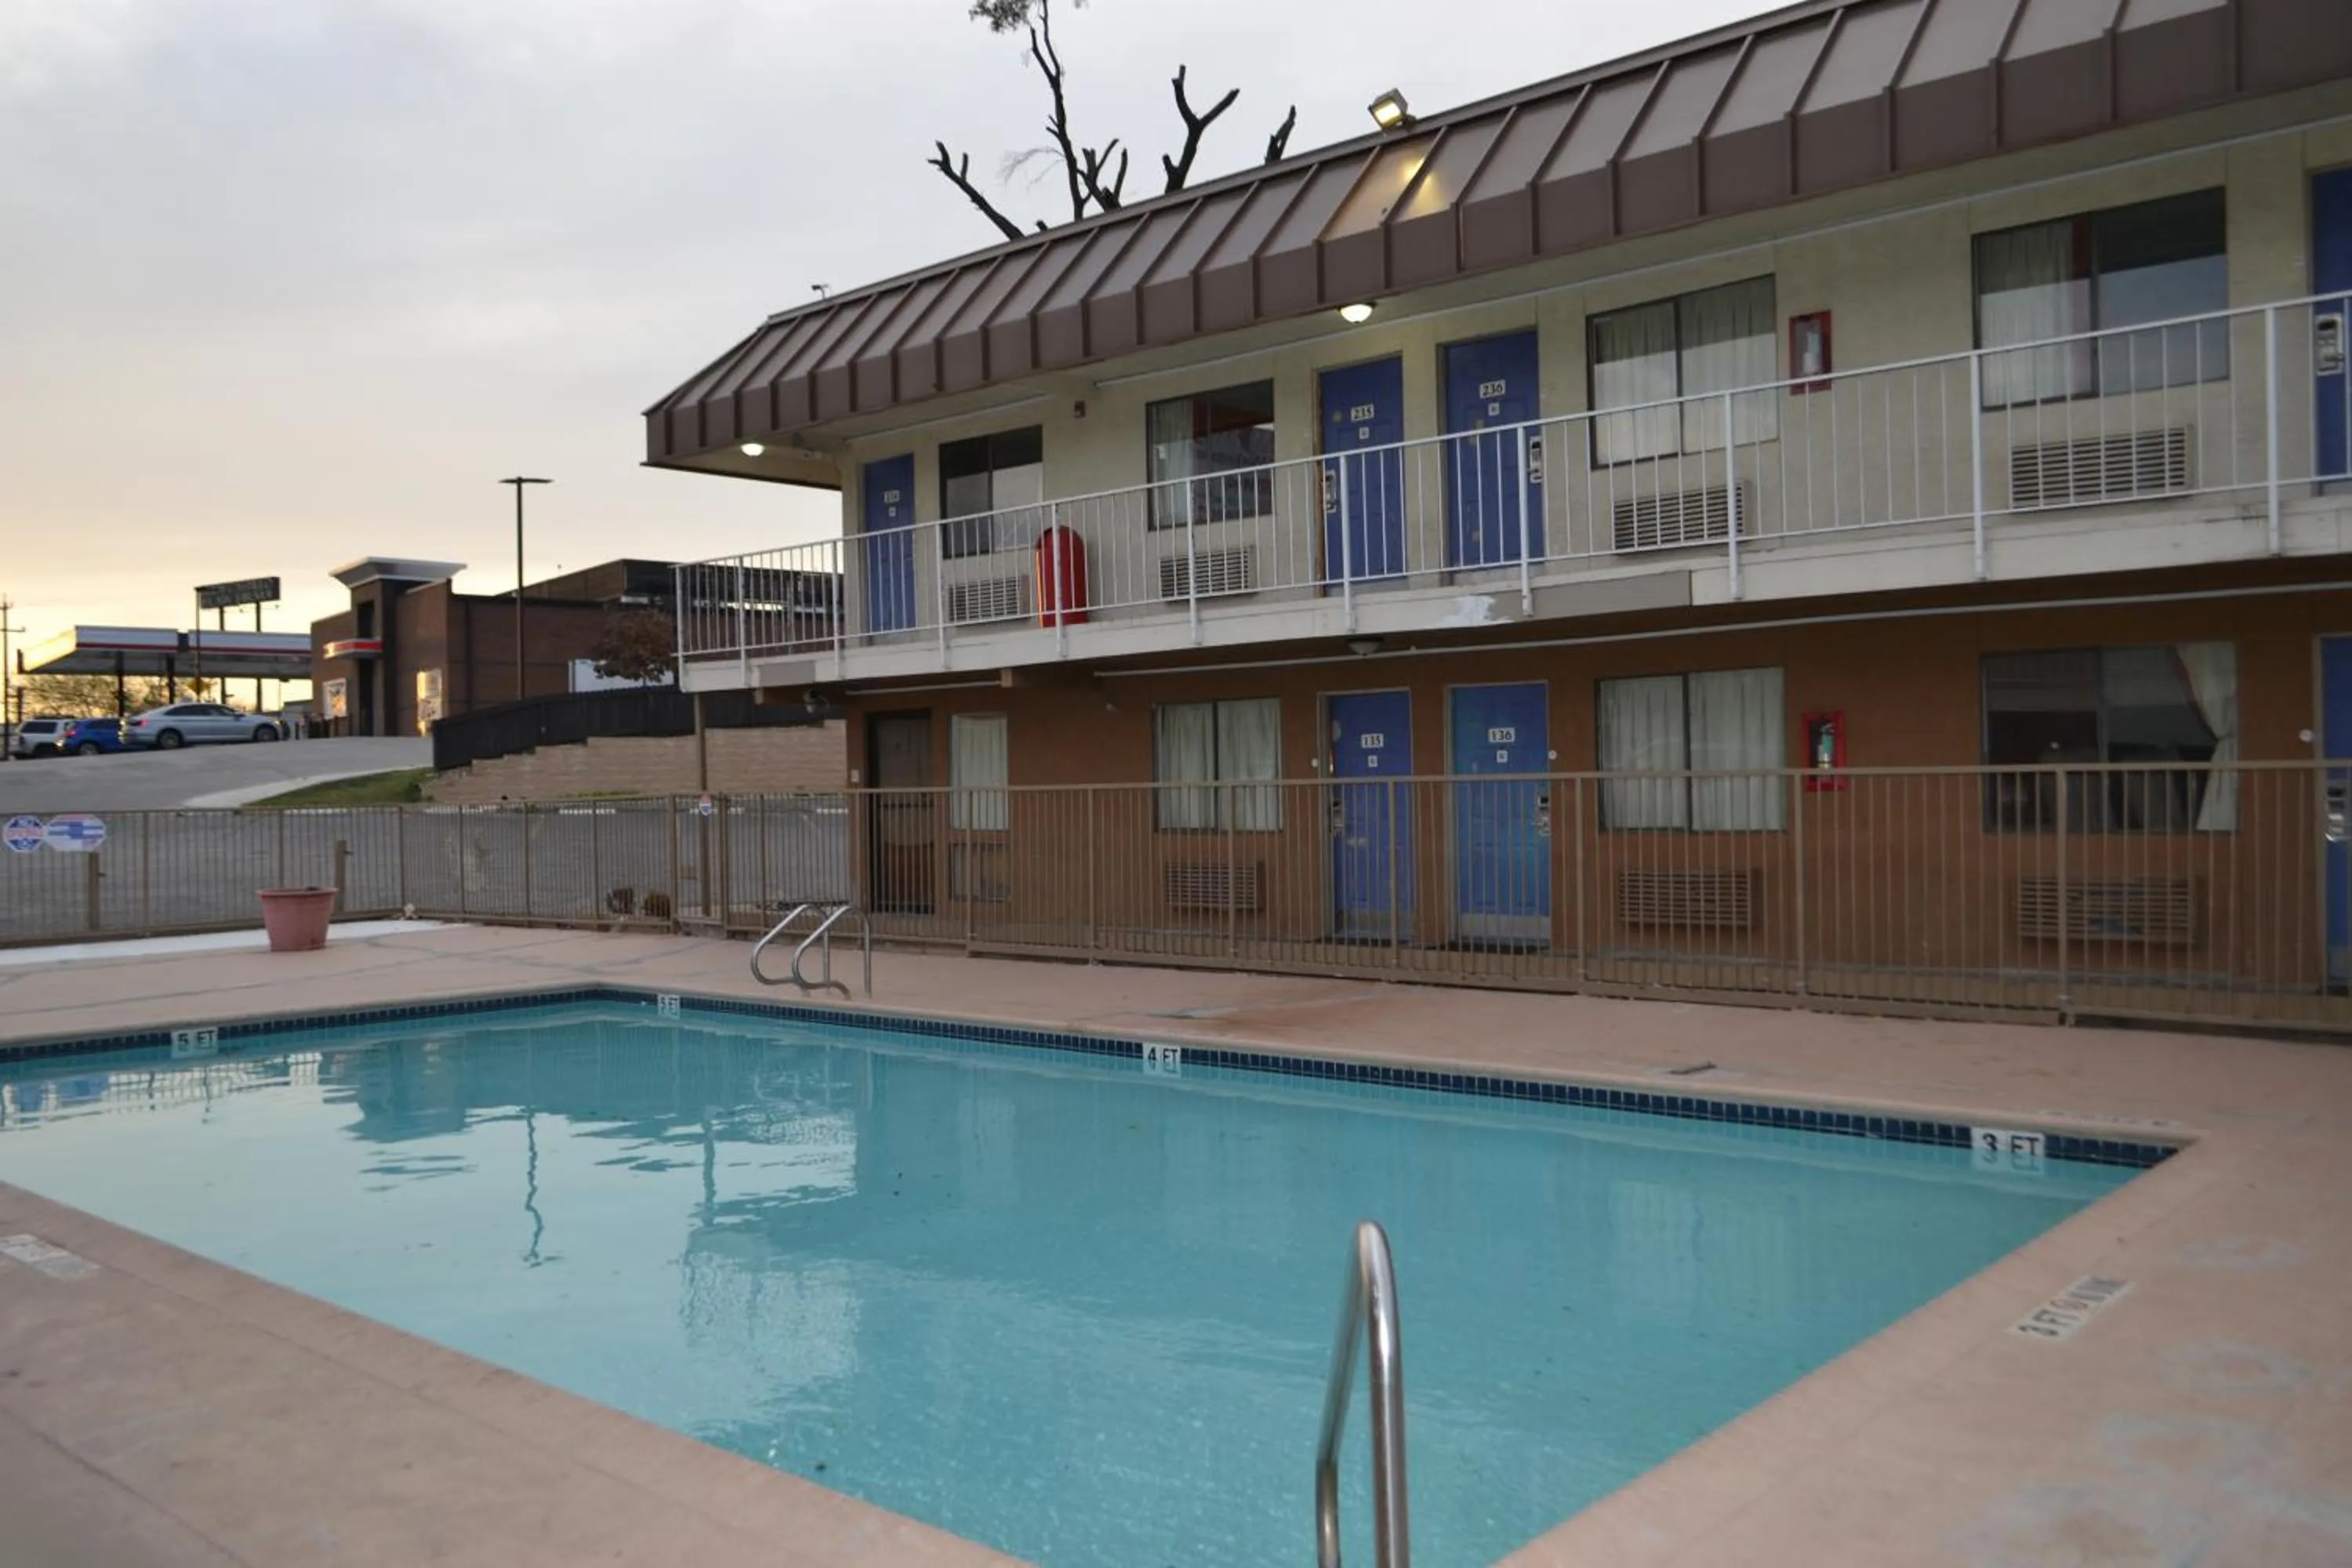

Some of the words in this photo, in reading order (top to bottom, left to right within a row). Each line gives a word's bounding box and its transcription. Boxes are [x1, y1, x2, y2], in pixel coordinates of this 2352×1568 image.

[1491, 729, 1512, 741] 136
[177, 1032, 189, 1044] 5
[1148, 1046, 1157, 1061] 4
[1163, 1047, 1178, 1063] FT
[1981, 1131, 1998, 1152] 3
[2010, 1134, 2041, 1155] FT
[2017, 1323, 2060, 1337] 3
